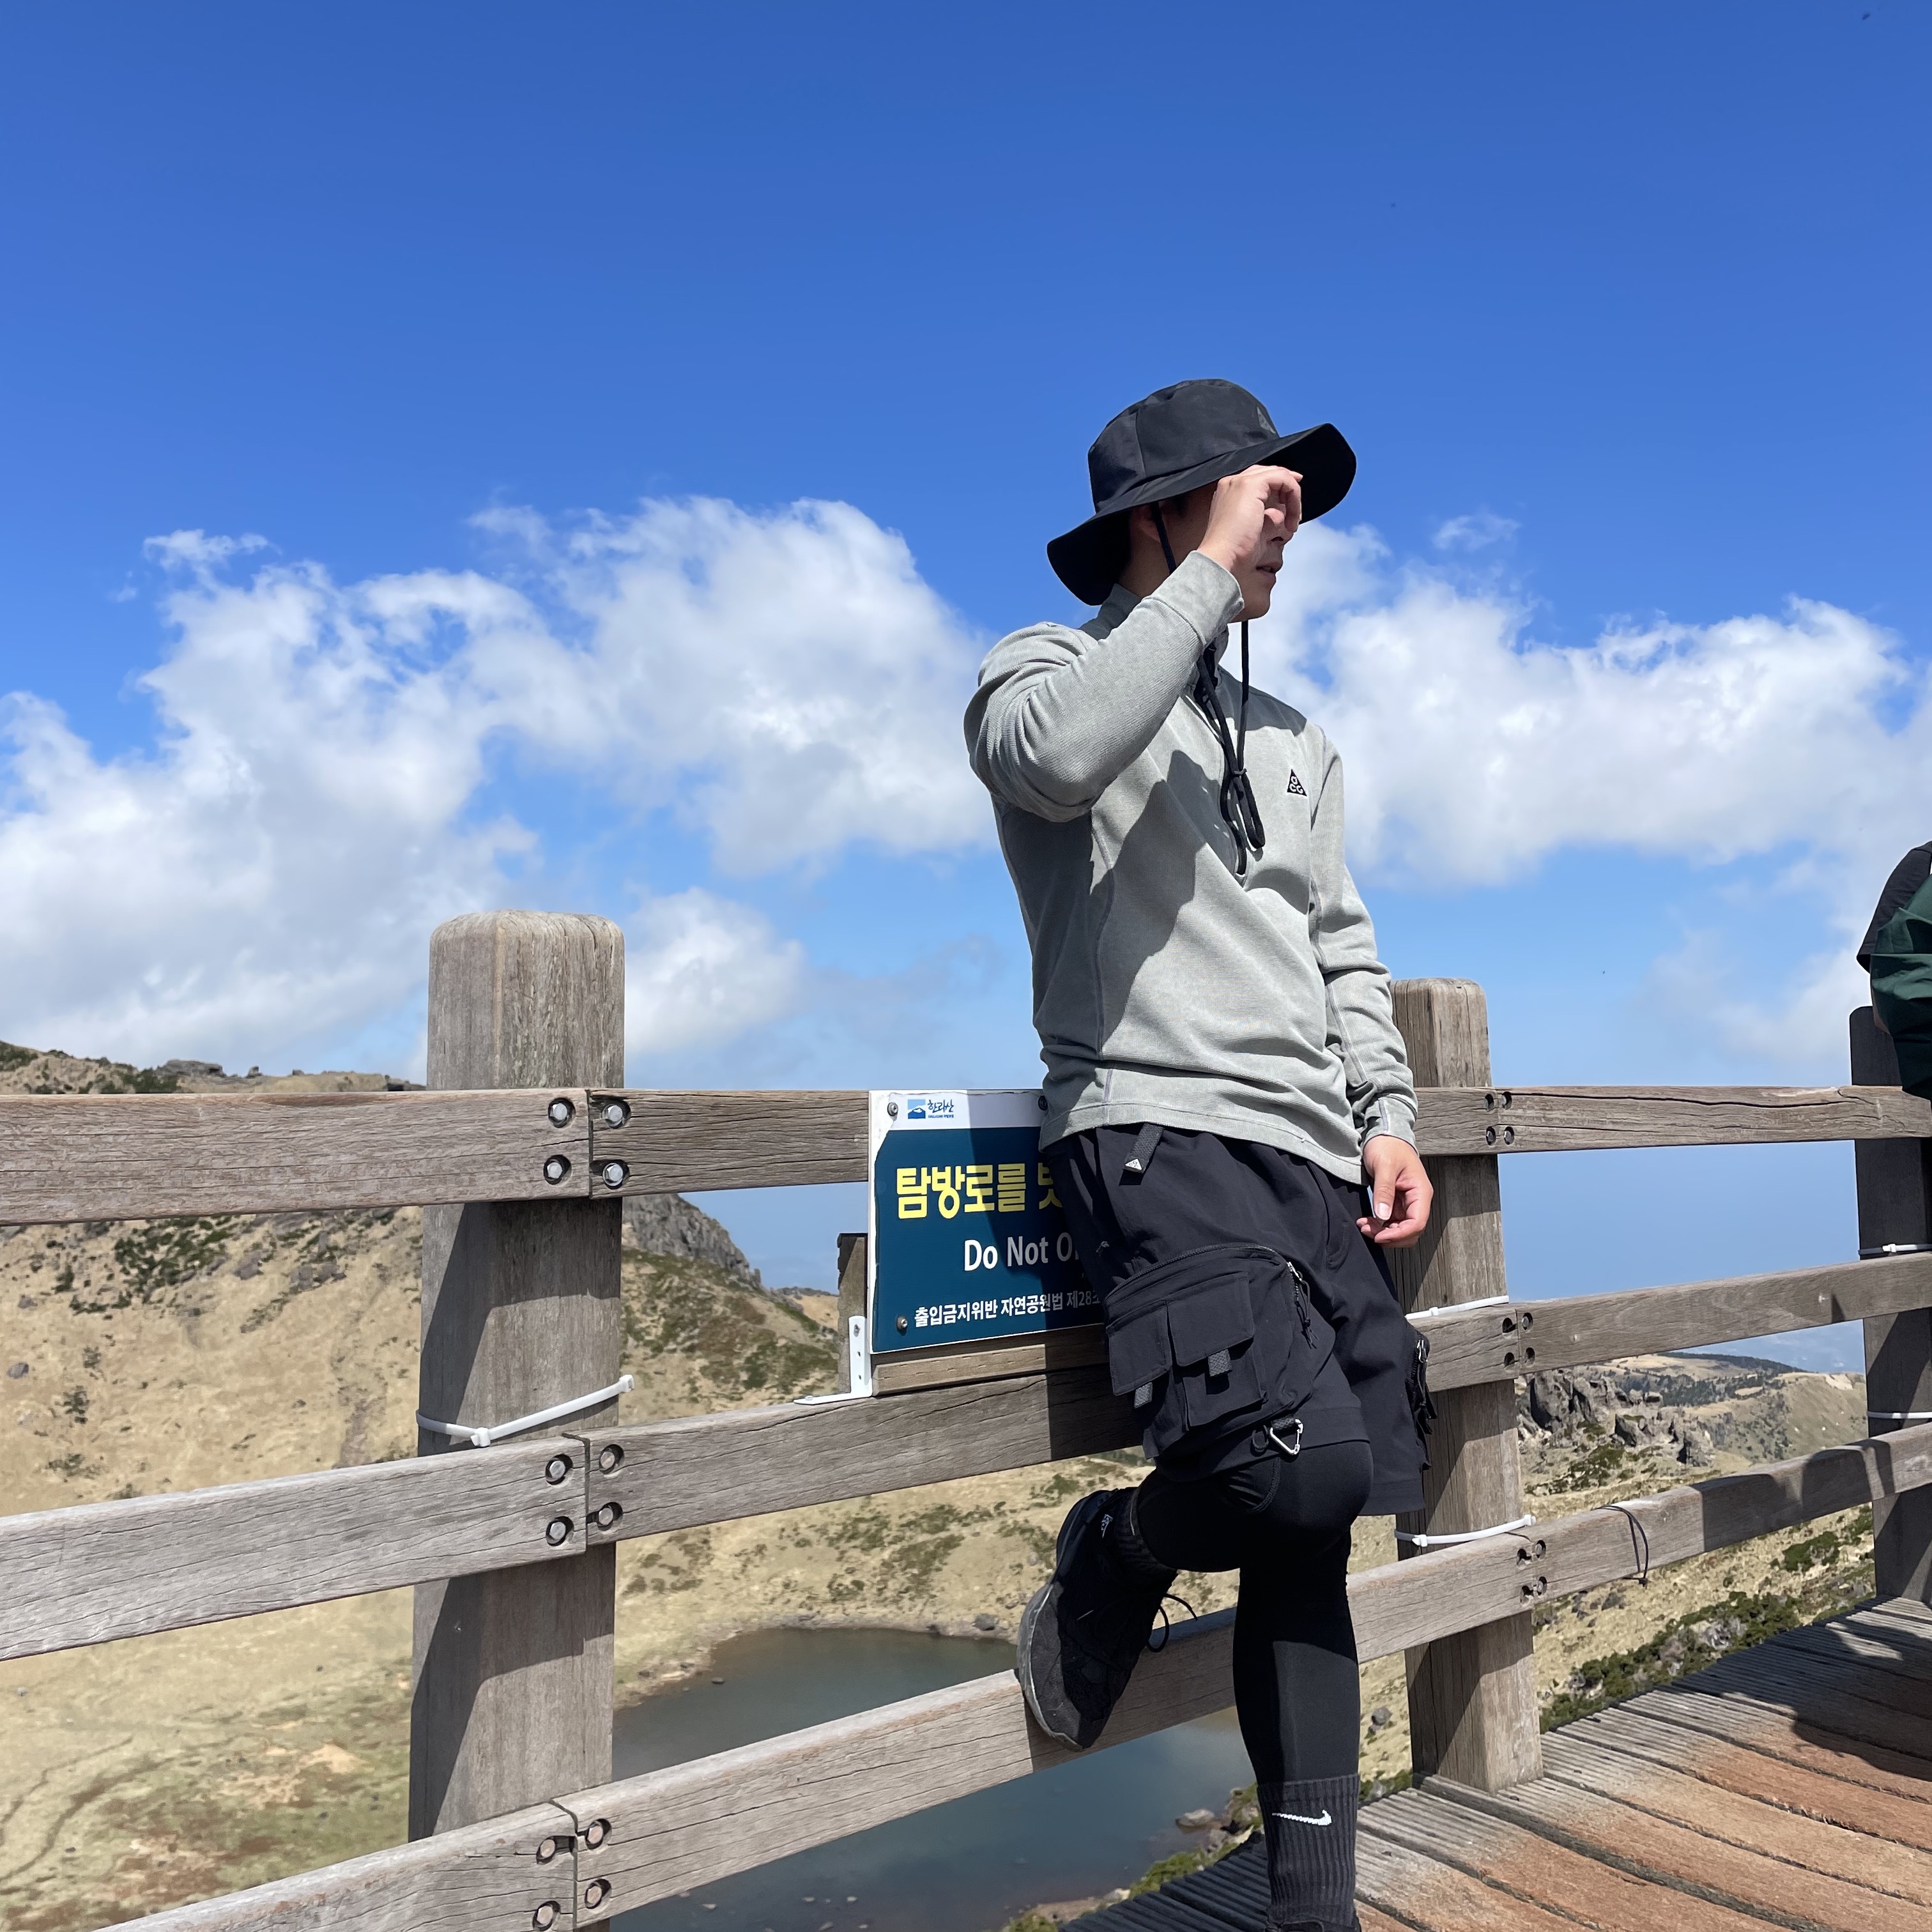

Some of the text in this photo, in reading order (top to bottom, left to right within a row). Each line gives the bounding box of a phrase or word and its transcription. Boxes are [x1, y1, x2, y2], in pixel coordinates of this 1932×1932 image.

[928, 1099, 954, 1114] 한라산
[896, 1163, 1026, 1219] 탐방로를
[964, 1232, 1079, 1271] Do Not O
[914, 1299, 998, 1328] 출입금지위반
[1000, 1292, 1063, 1316] 자연공원법
